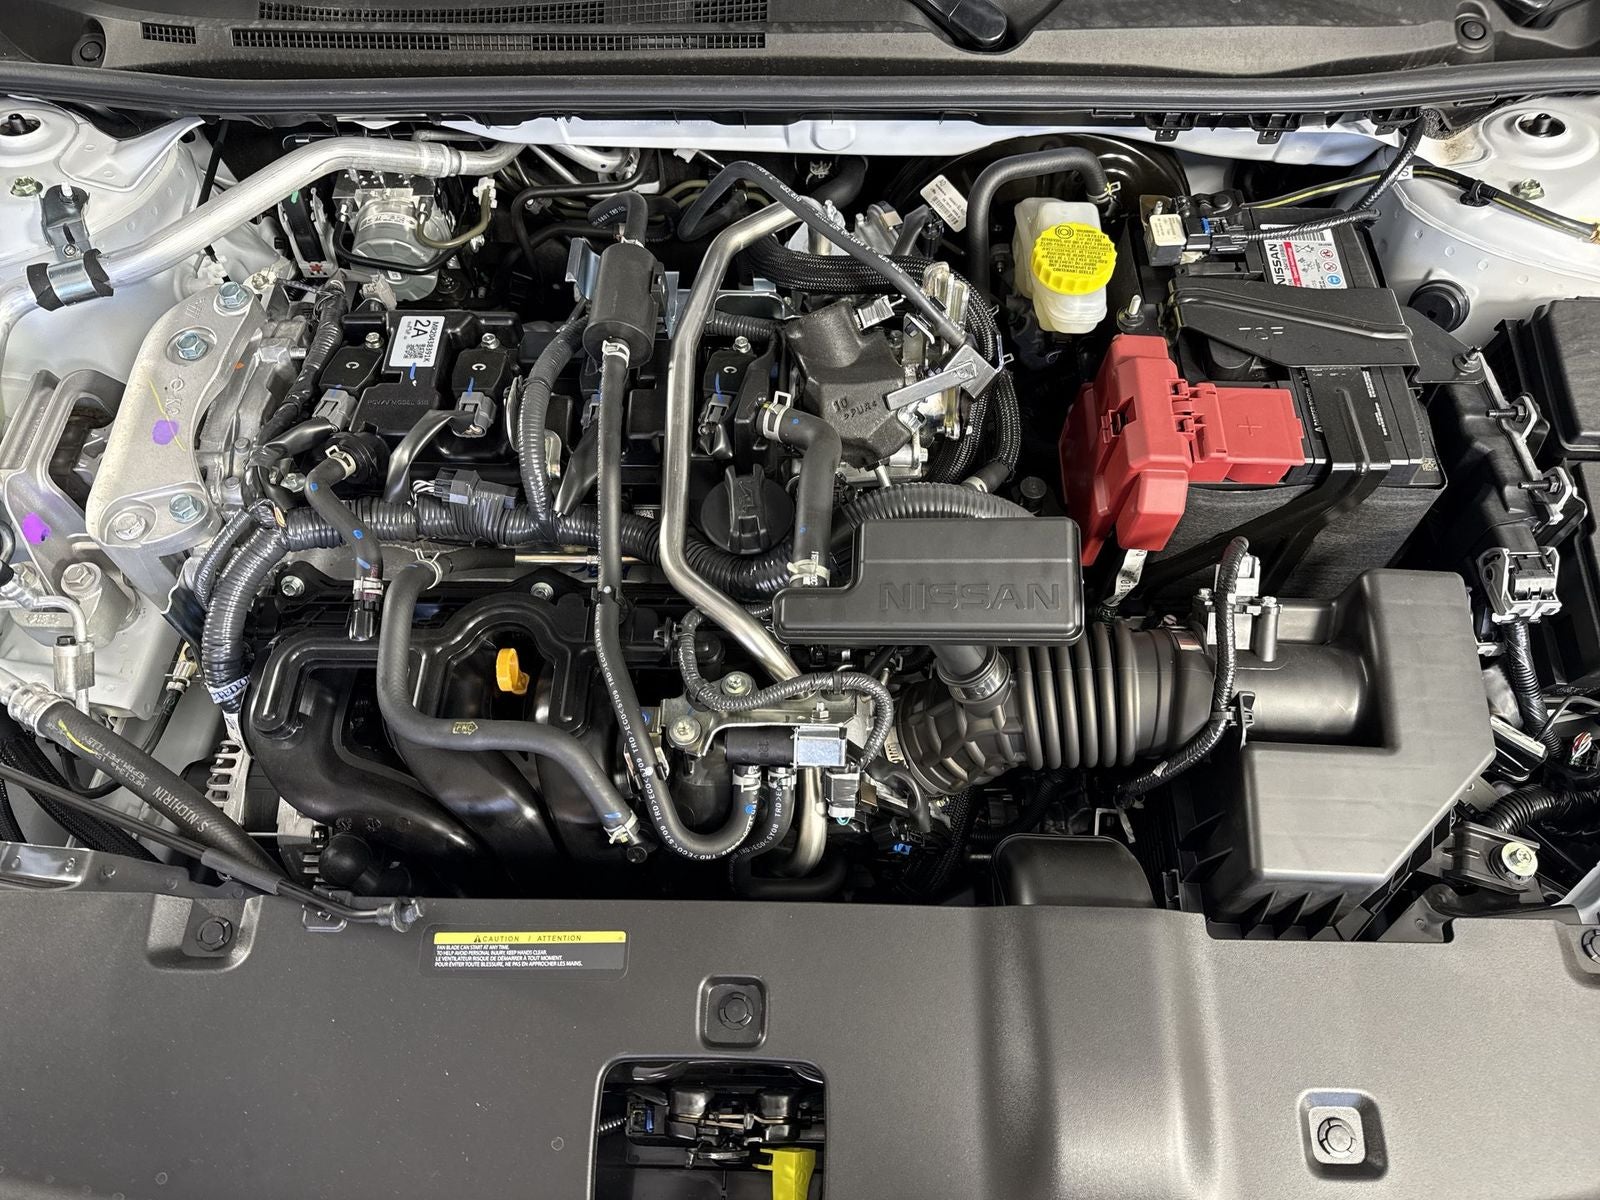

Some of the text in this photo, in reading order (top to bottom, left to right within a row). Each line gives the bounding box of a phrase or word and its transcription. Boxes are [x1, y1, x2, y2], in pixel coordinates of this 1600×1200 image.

[1268, 243, 1286, 284] NISSAN
[411, 320, 431, 338] 2A
[880, 583, 1060, 610] NISSAN
